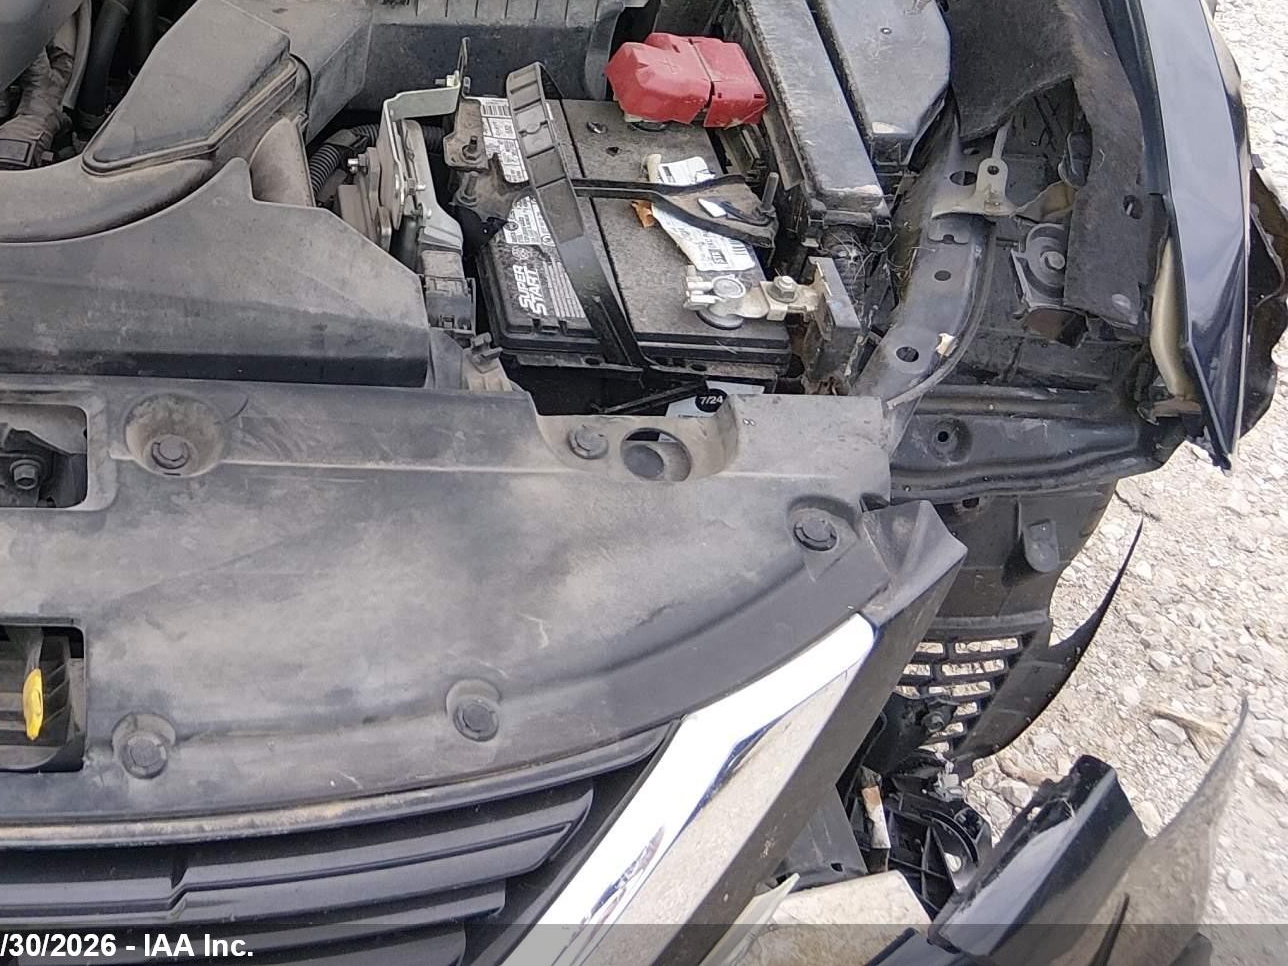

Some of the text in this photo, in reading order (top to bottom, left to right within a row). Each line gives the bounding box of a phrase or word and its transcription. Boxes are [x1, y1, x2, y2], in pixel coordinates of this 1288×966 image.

[512, 264, 533, 309] SUPER
[523, 264, 549, 316] START
[699, 395, 724, 406] 7/24
